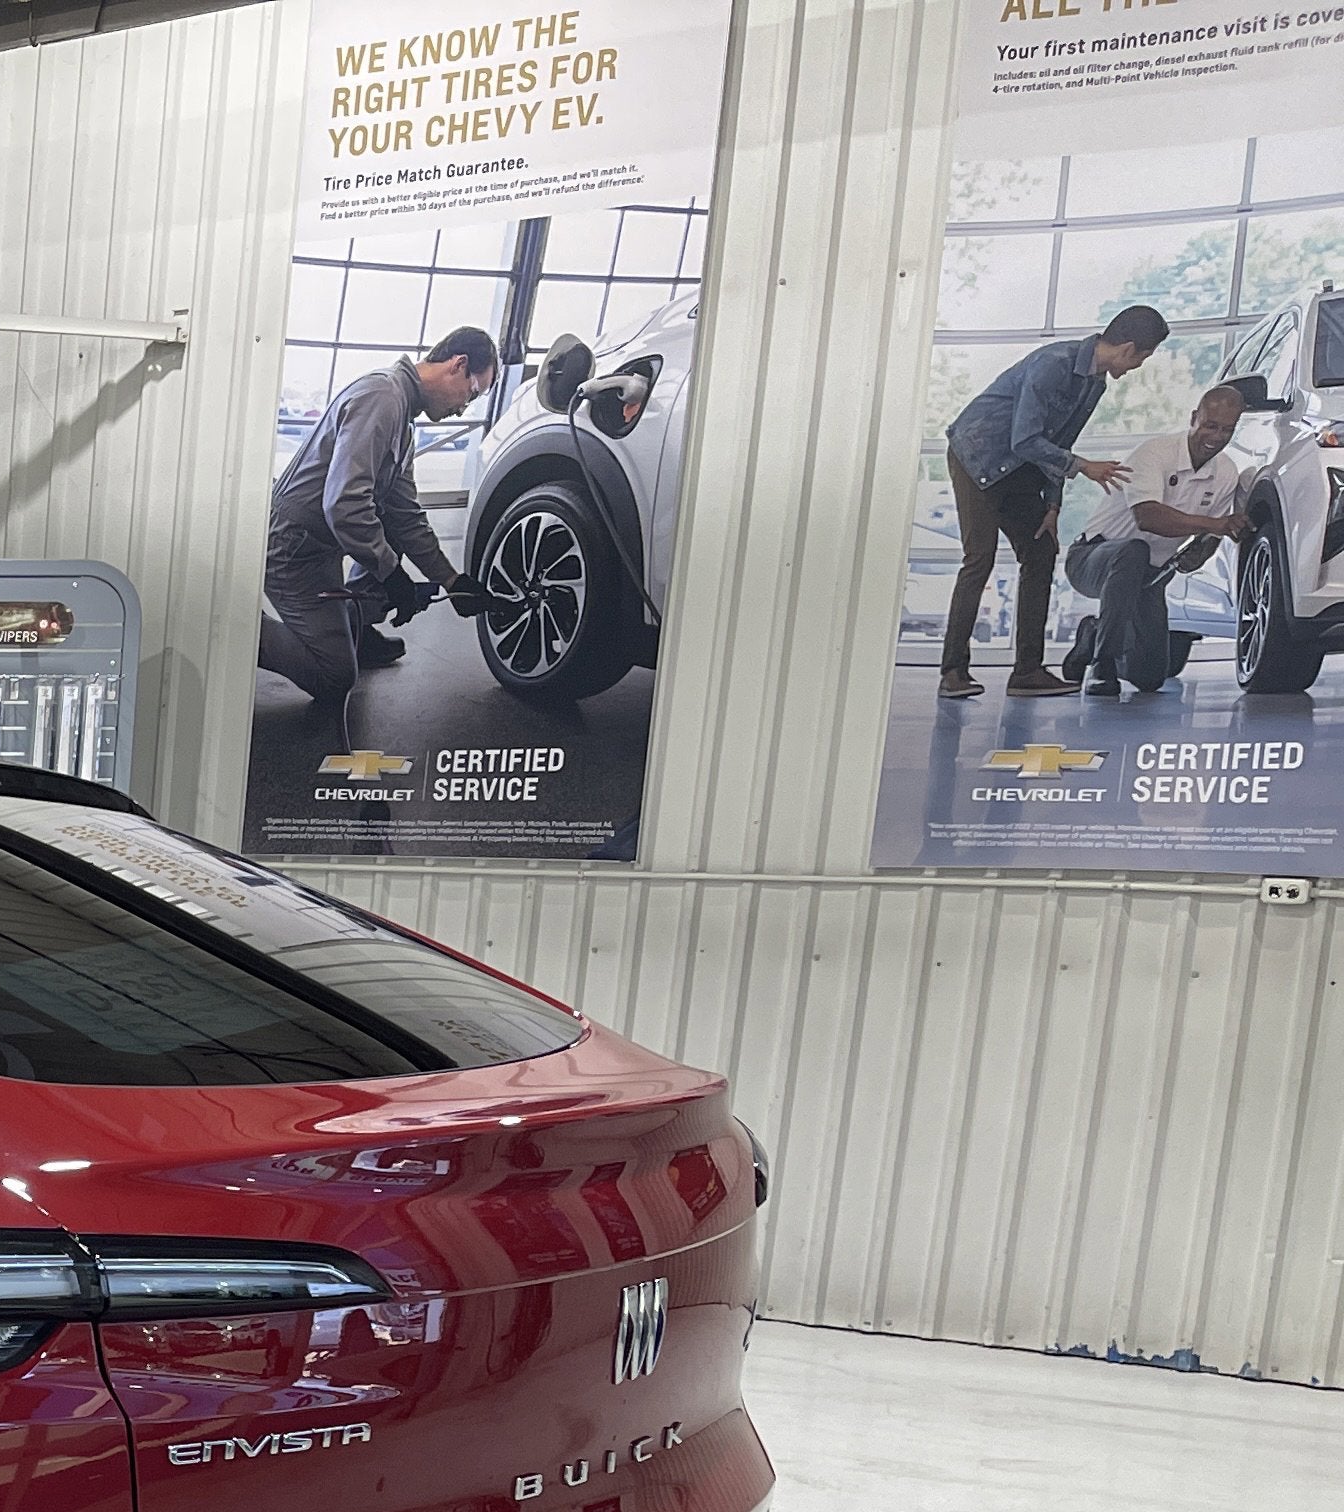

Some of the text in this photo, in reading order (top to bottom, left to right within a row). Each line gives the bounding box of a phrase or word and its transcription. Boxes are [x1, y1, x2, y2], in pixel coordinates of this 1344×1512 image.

[336, 11, 580, 77] WE KNOW THE
[997, 45, 1039, 61] Your
[1044, 39, 1085, 57] first
[1091, 25, 1217, 53] maintenance
[1224, 16, 1267, 36] visit
[1273, 13, 1290, 30] is
[1052, 66, 1070, 76] and
[1087, 63, 1112, 74] filter
[1155, 54, 1186, 66] diesel
[1187, 49, 1229, 62] exhaust
[1230, 45, 1254, 57] fluid
[1256, 42, 1282, 54] tank
[331, 48, 618, 117] RIGHT TIRES FOR
[1065, 79, 1084, 88] and
[1143, 70, 1179, 81] Vehicle
[328, 93, 604, 158] YOUR CHEVY EV.
[324, 157, 529, 192] Tire Price Match Guarantee.
[362, 196, 378, 206] with
[388, 193, 410, 204] better
[442, 188, 462, 198] price
[475, 184, 488, 193] the
[490, 182, 508, 191] time
[510, 180, 519, 188] of
[562, 172, 578, 182] and
[600, 166, 627, 176] match
[344, 209, 368, 218] better
[370, 207, 389, 218] price
[392, 203, 415, 214] within
[417, 203, 426, 212] 30
[428, 200, 446, 210] days
[448, 198, 458, 208] of
[459, 197, 471, 206] the
[514, 190, 530, 200] and
[552, 184, 580, 195] refund
[582, 181, 596, 190] the
[436, 747, 565, 773] CERTIFIED
[1136, 742, 1304, 770] CERTIFIED
[314, 788, 415, 802] CHEVROLET
[432, 777, 538, 802] SERVICE
[972, 787, 1107, 802] CHEVROLET
[1132, 776, 1272, 804] SERVICE
[168, 1422, 372, 1466] ENVISTA
[514, 1421, 684, 1500] BUICK
